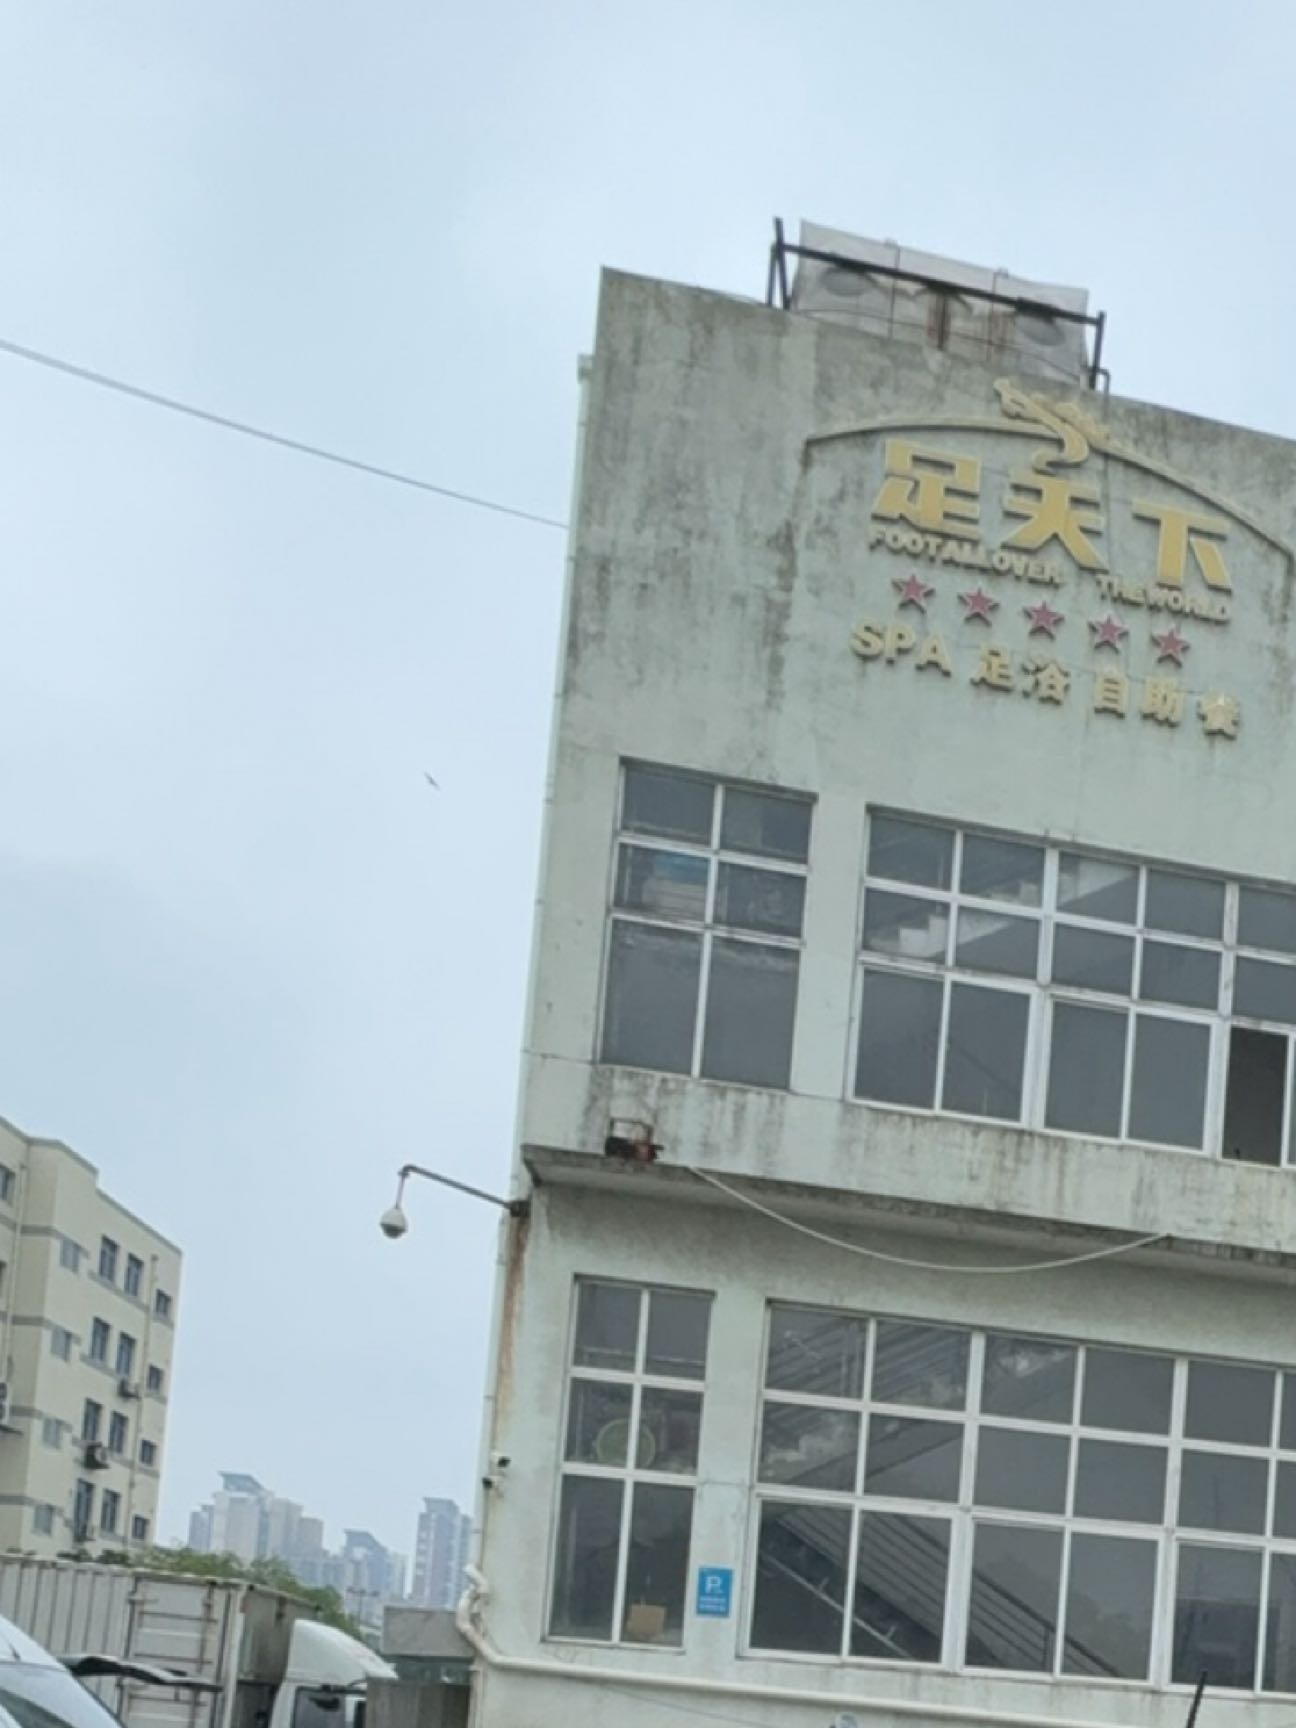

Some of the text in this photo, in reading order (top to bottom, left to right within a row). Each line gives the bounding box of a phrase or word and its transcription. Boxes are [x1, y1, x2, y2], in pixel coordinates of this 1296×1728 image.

[870, 438, 1233, 594] 足天下
[850, 616, 953, 677] SPA
